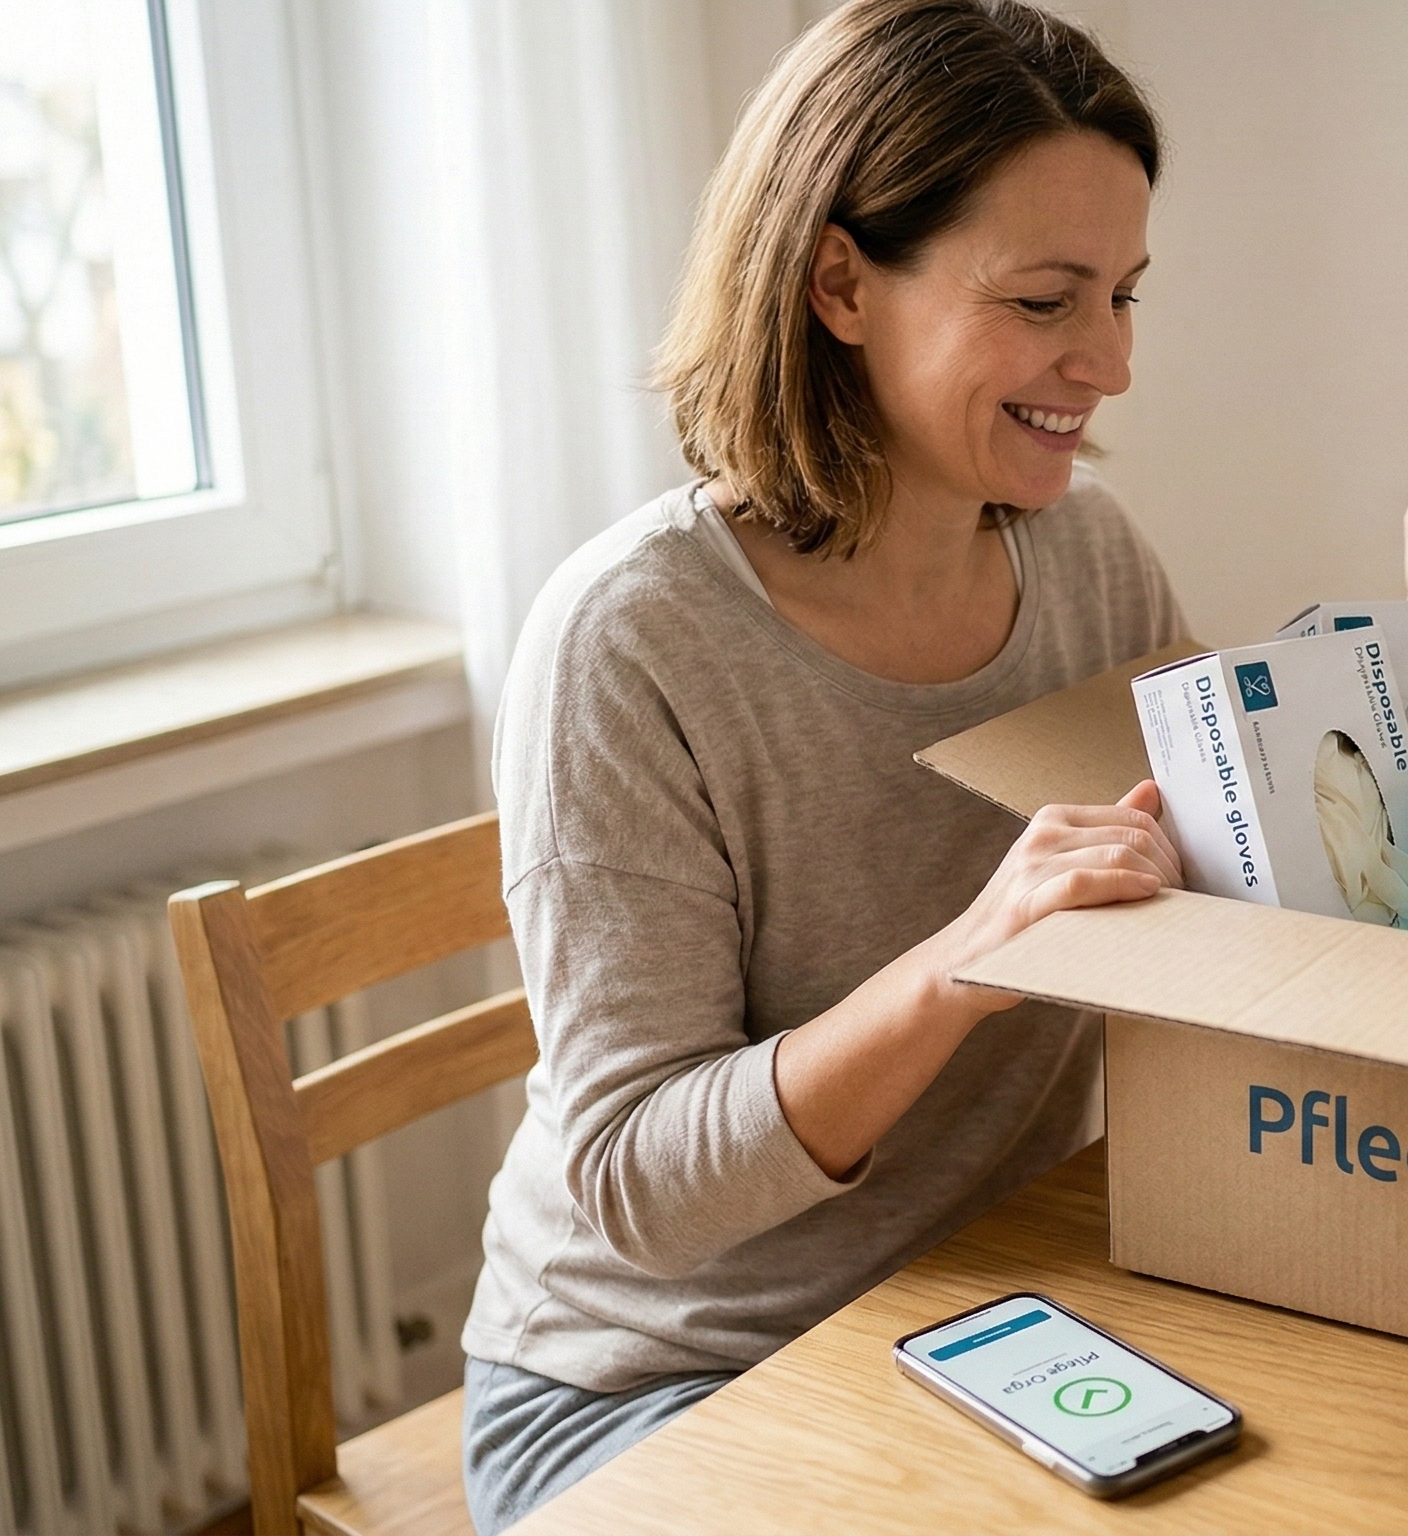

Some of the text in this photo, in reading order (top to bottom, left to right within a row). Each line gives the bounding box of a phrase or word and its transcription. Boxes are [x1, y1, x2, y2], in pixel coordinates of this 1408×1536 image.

[1365, 642, 1408, 771] Disposable
[1195, 675, 1258, 887] Disposable gloves
[1002, 1351, 1100, 1394] Pflege Orga
